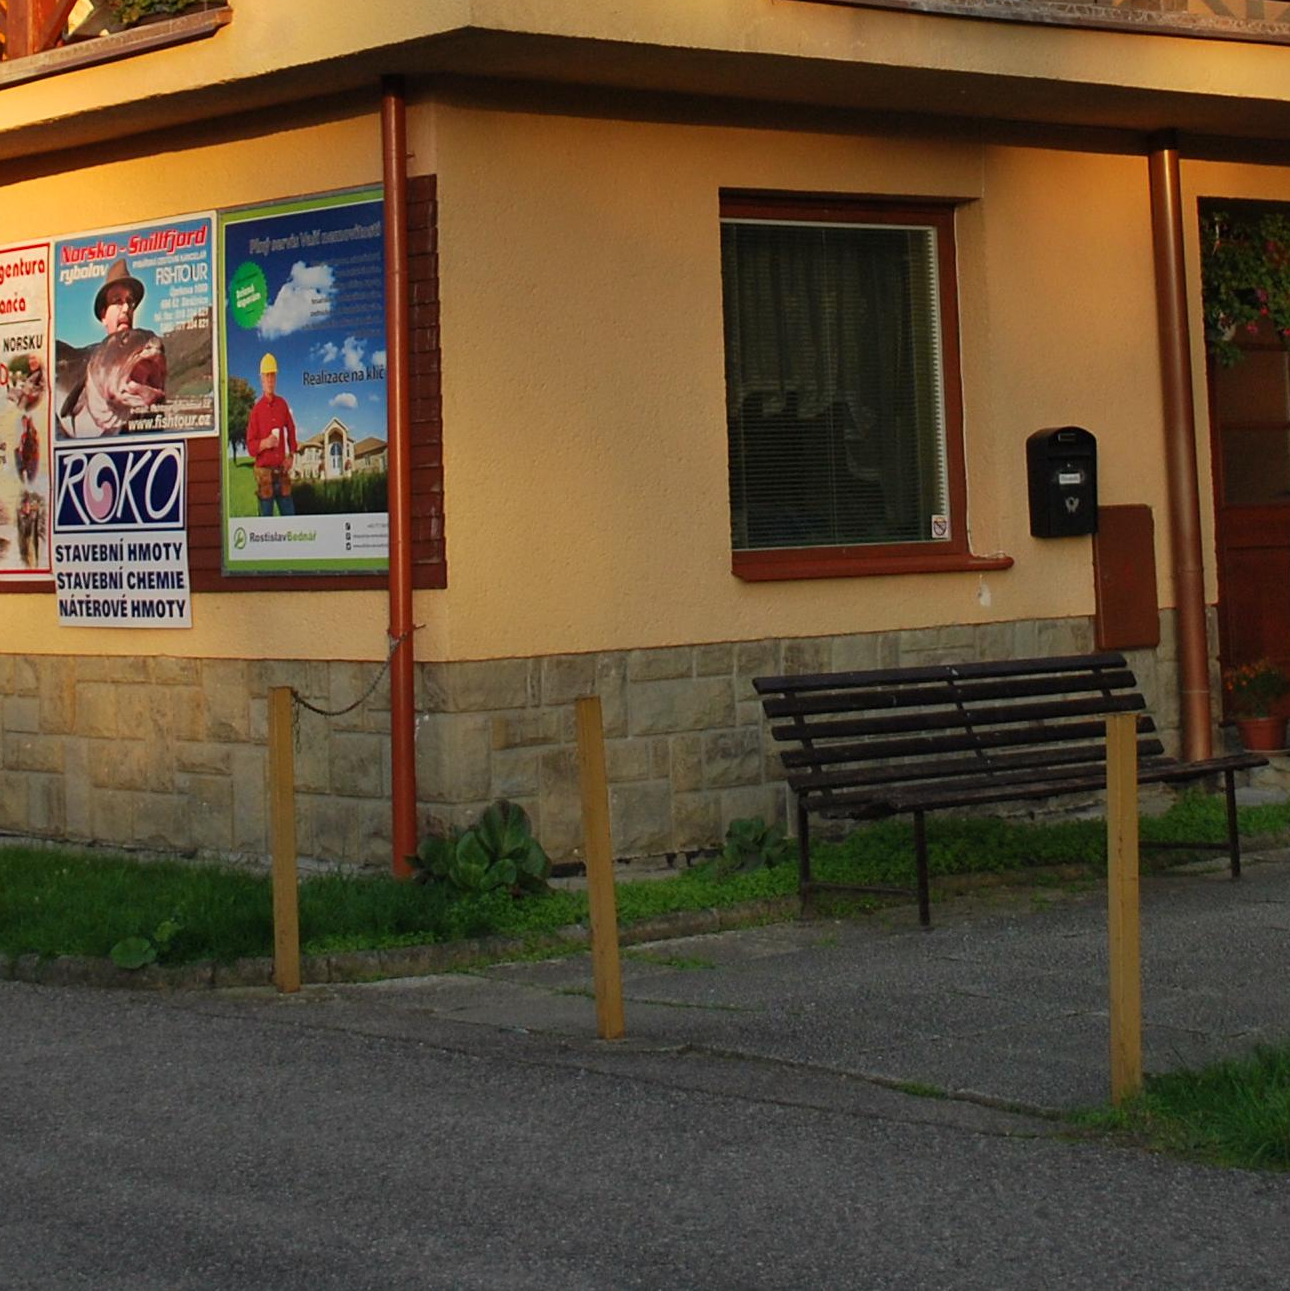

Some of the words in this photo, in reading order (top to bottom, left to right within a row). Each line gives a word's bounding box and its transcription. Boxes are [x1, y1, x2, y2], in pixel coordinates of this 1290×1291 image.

[60, 241, 117, 266] Norsko
[128, 224, 208, 256] Snillfjord
[59, 262, 109, 286] rybolov
[3, 333, 44, 353] NORSKU
[303, 370, 350, 386] Realizace
[351, 369, 365, 382] na
[128, 414, 212, 431] www.fishtour.cz
[58, 446, 183, 526] ROKO
[55, 538, 124, 562] STAVEBNÍ
[128, 542, 183, 562] HMOTY
[57, 566, 124, 590] STAVEBNÍ
[126, 570, 185, 590] CHEMIE
[59, 593, 128, 618] NÁTĚROVÉ
[131, 599, 186, 618] HMOTY
